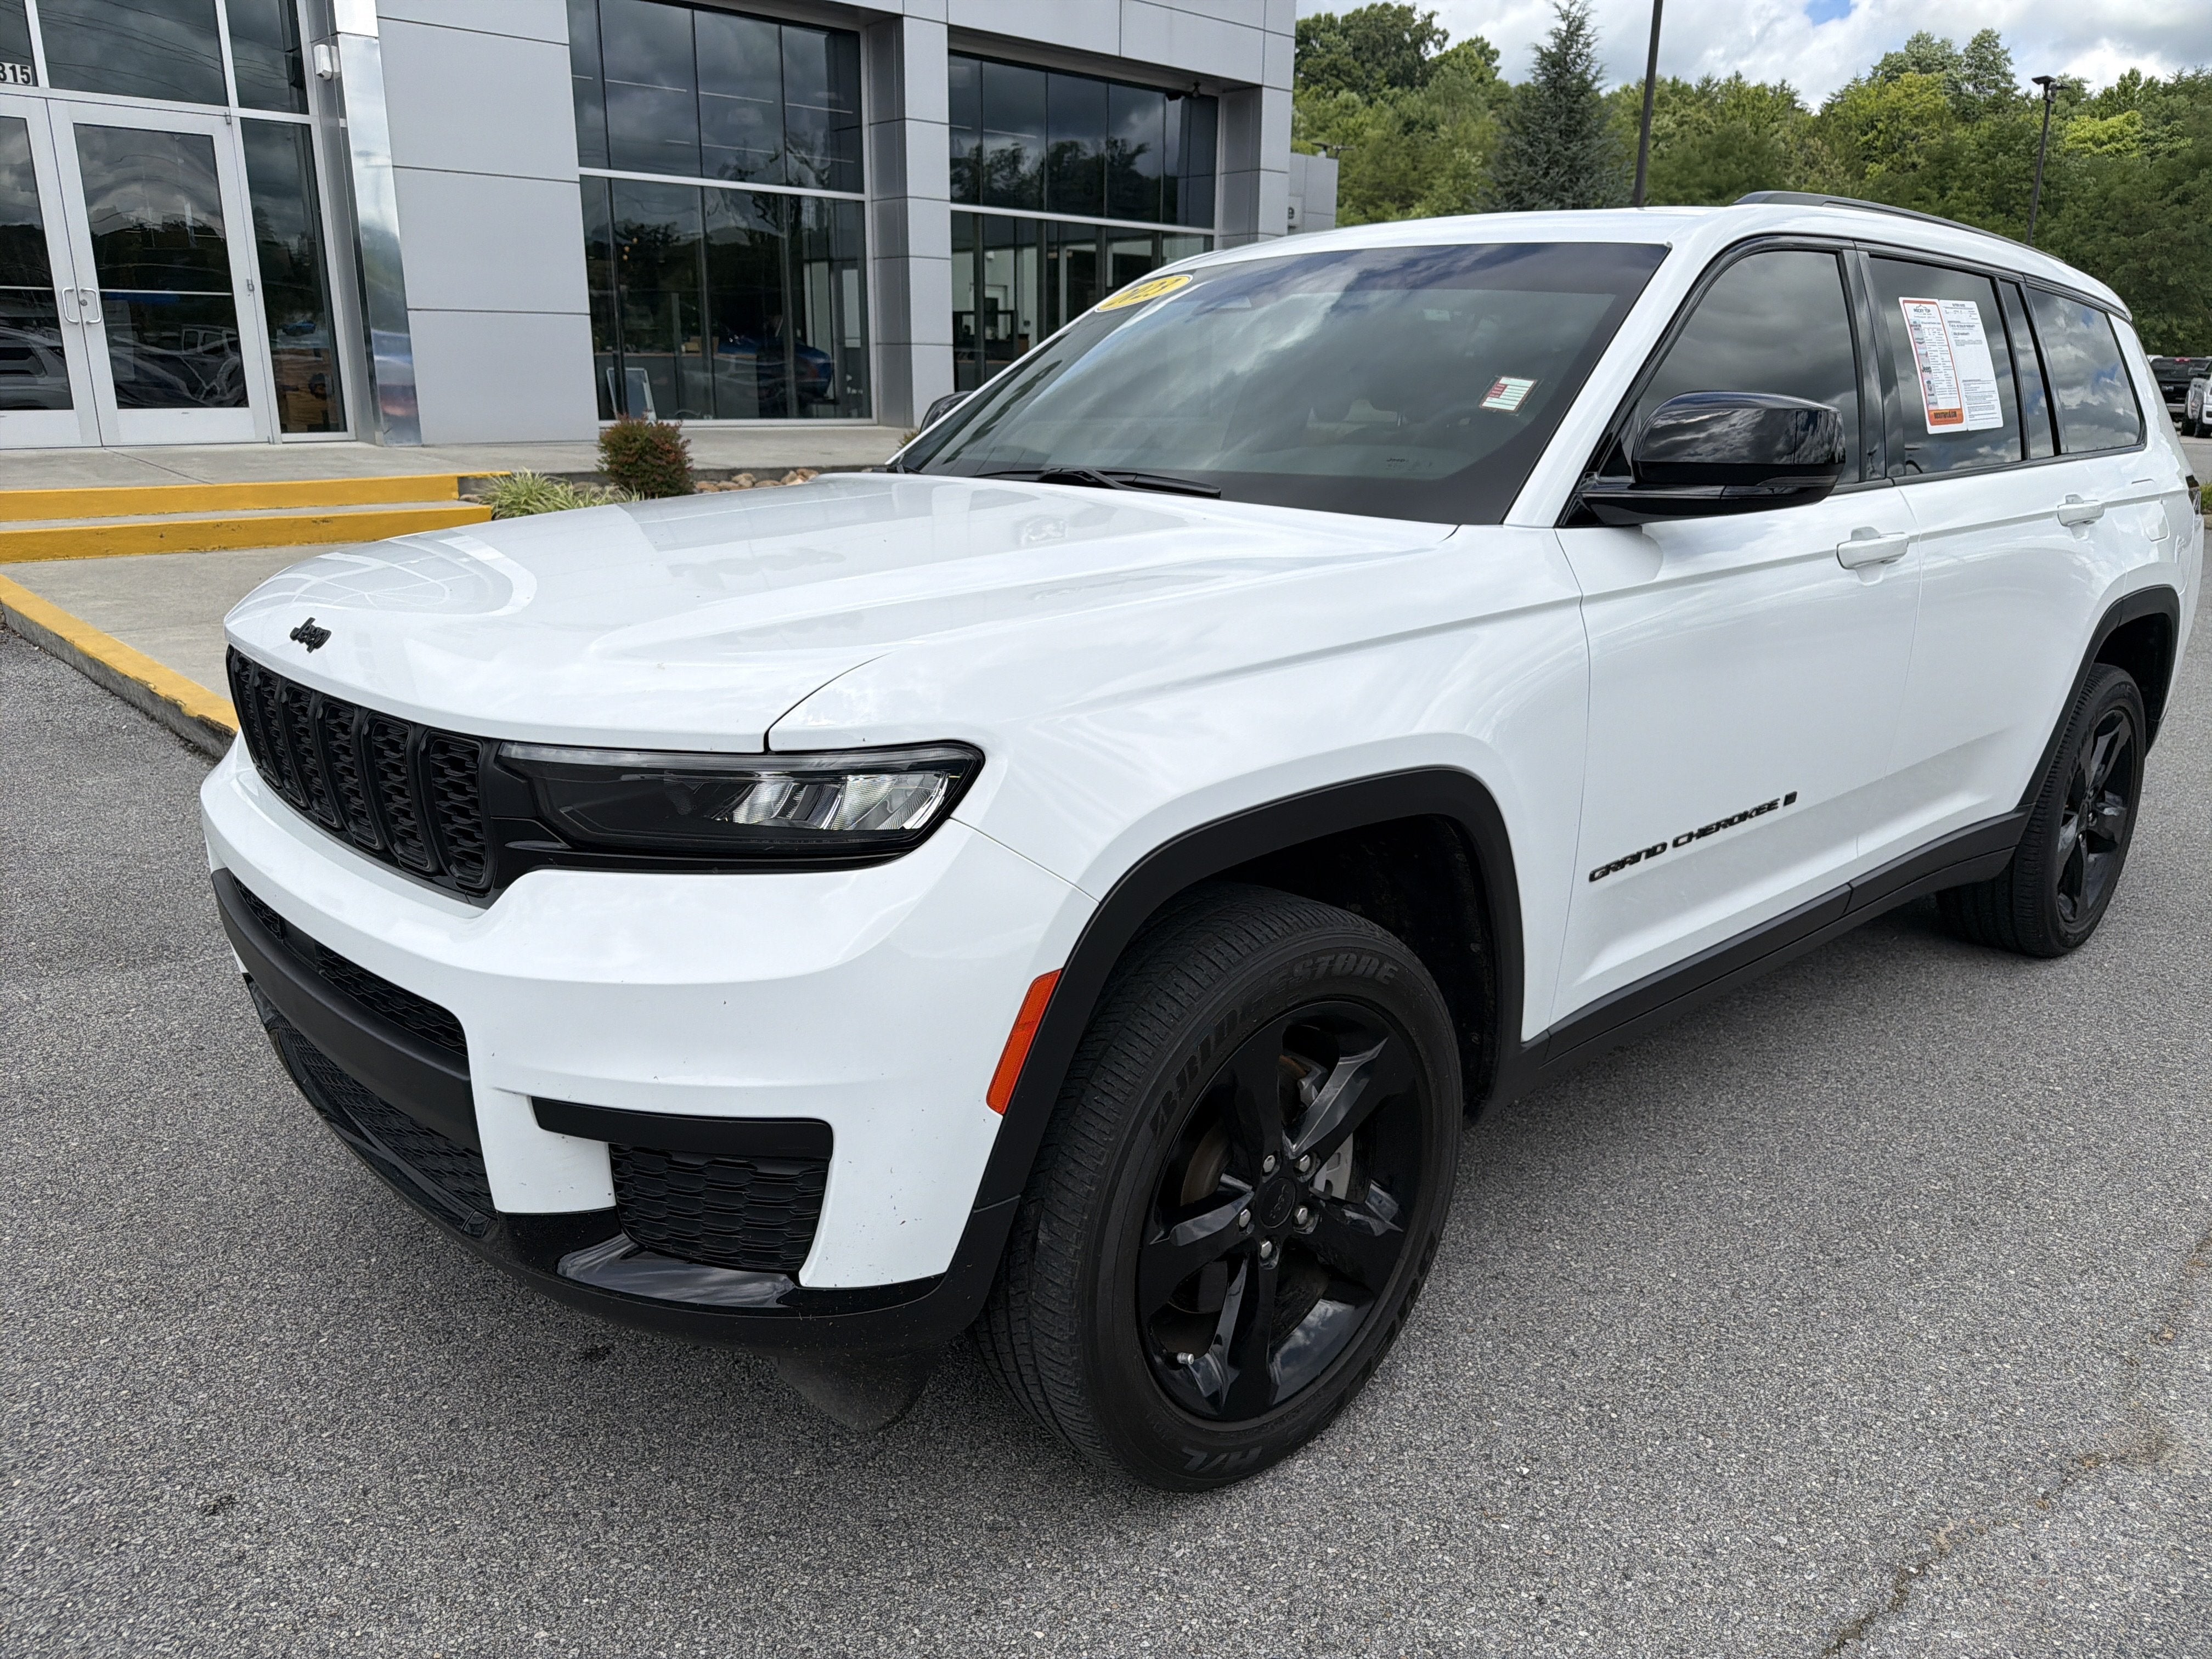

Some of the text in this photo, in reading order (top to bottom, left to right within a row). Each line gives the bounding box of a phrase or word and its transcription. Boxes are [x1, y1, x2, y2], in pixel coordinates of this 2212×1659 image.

[289, 617, 332, 653] Jeep
[1589, 798, 1780, 882] GRAND CHEROKEE
